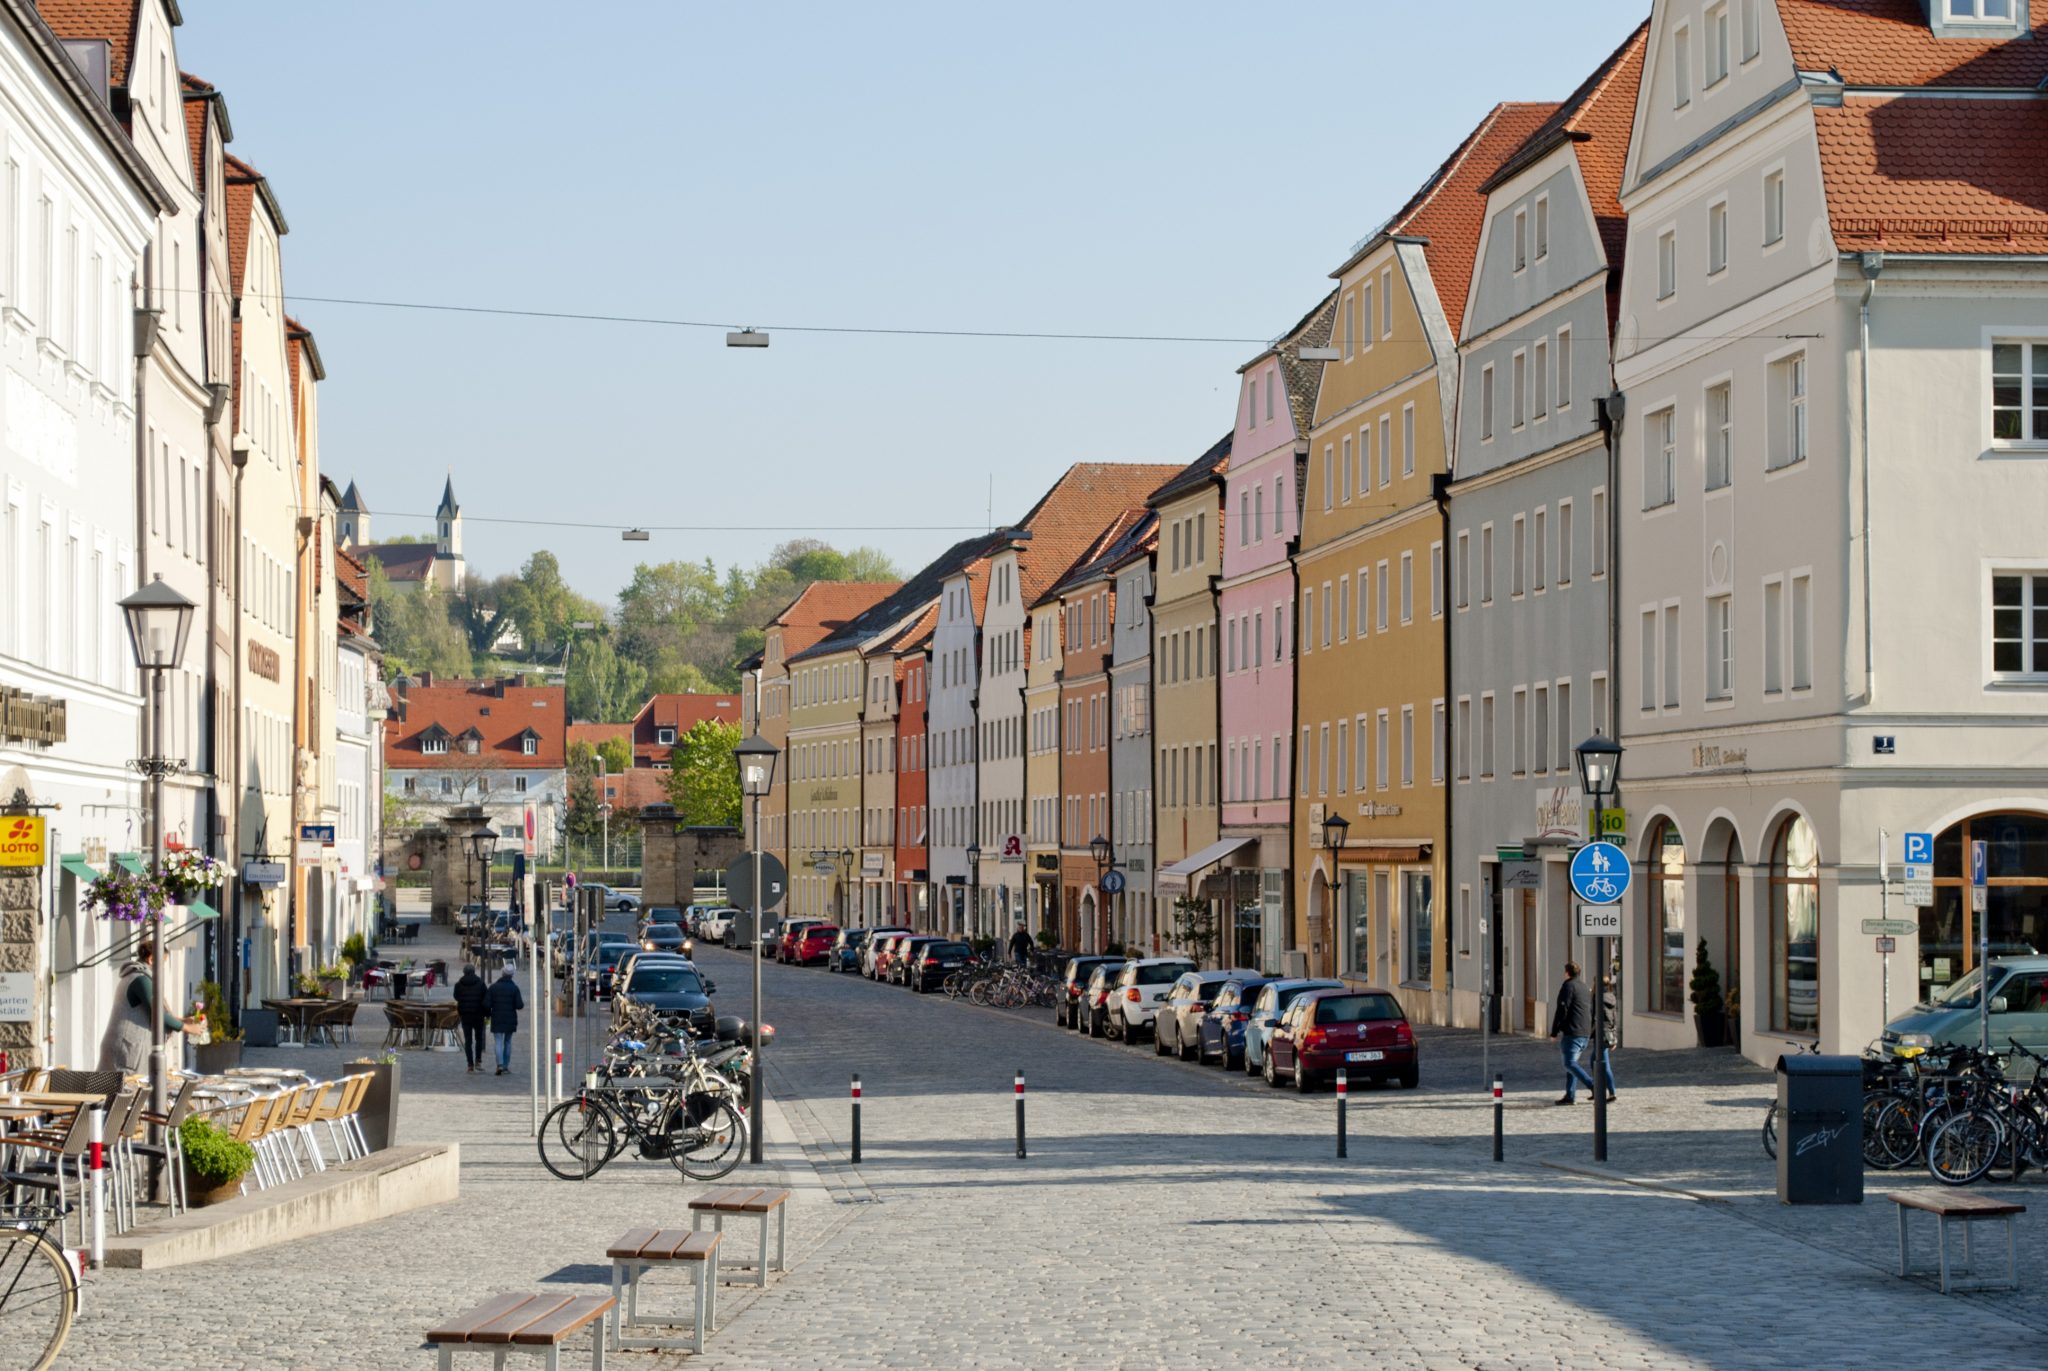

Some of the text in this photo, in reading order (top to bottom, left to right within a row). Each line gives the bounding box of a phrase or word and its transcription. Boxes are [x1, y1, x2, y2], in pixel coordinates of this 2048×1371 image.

[1, 843, 39, 853] LOTTO
[1908, 836, 1925, 860] P
[1974, 846, 1983, 881] P
[1584, 914, 1617, 926] Ende
